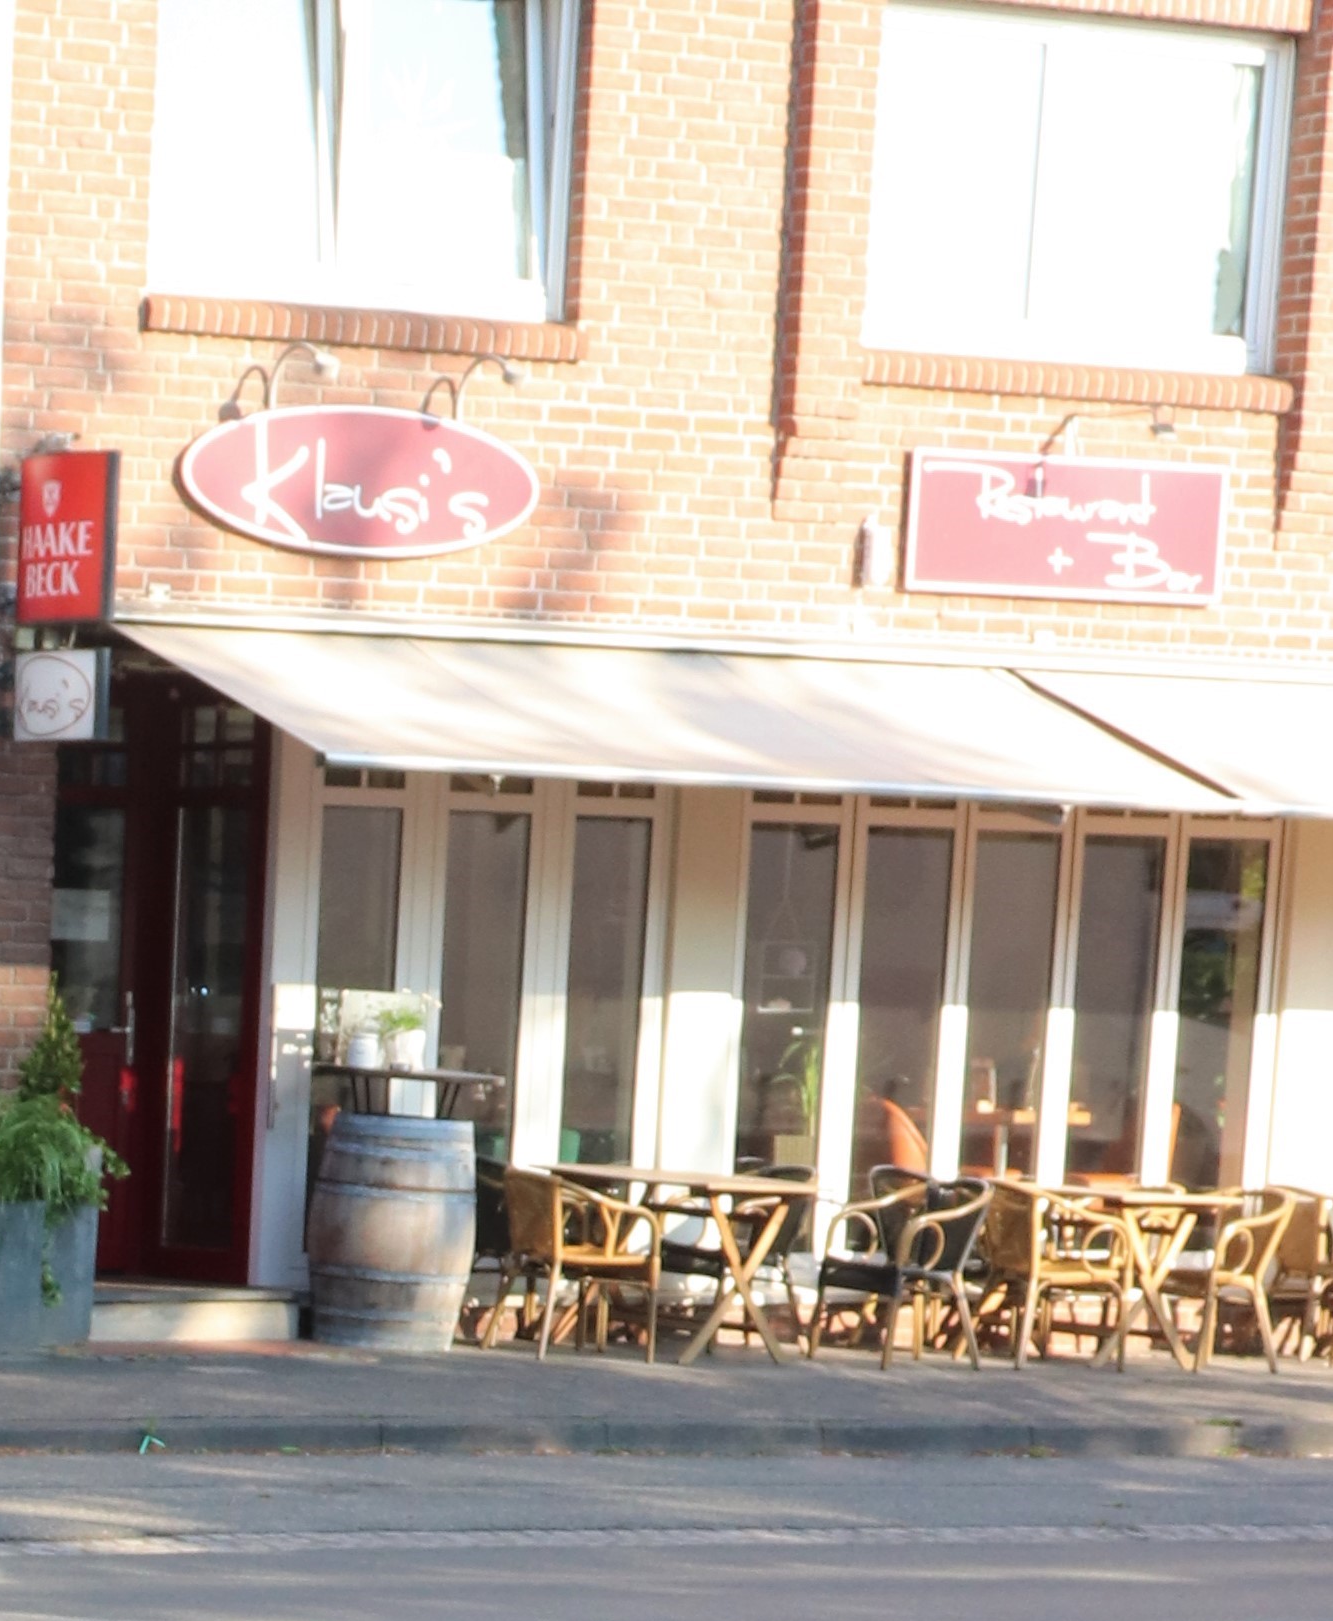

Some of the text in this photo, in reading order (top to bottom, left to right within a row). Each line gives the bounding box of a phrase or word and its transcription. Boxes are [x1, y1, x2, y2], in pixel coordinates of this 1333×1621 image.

[241, 416, 489, 543] Klausi's
[21, 520, 94, 560] HAAKE
[1085, 531, 1203, 593] Bar
[25, 560, 81, 598] BECK
